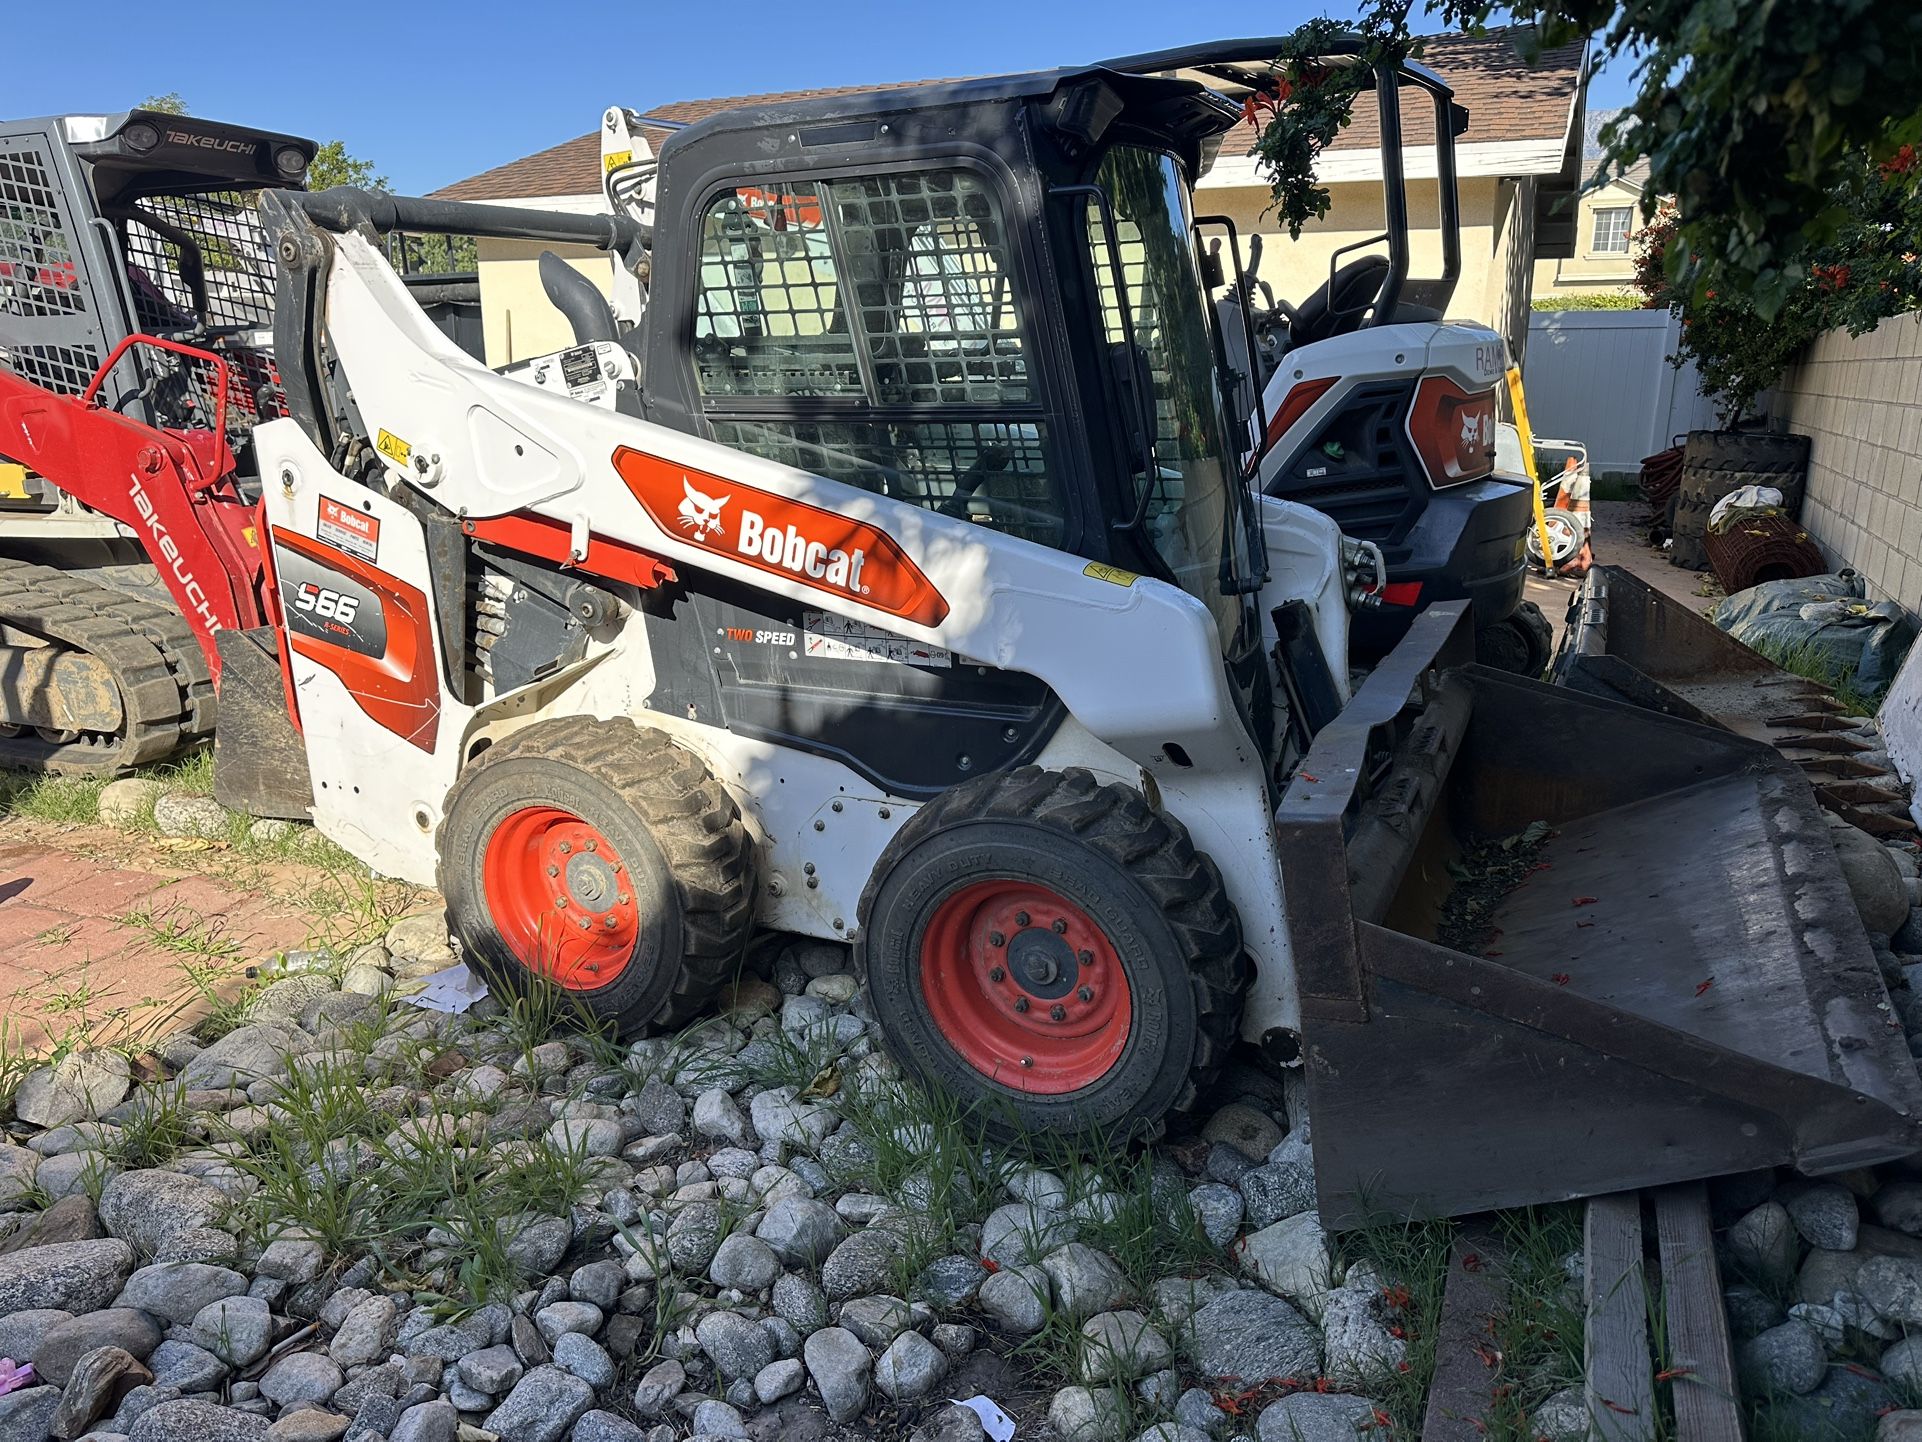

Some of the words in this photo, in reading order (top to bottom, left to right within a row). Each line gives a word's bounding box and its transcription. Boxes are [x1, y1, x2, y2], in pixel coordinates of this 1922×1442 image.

[340, 510, 369, 533] Bobcat
[294, 582, 360, 625] S66
[727, 627, 753, 642] TWO
[755, 630, 796, 646] SPEED
